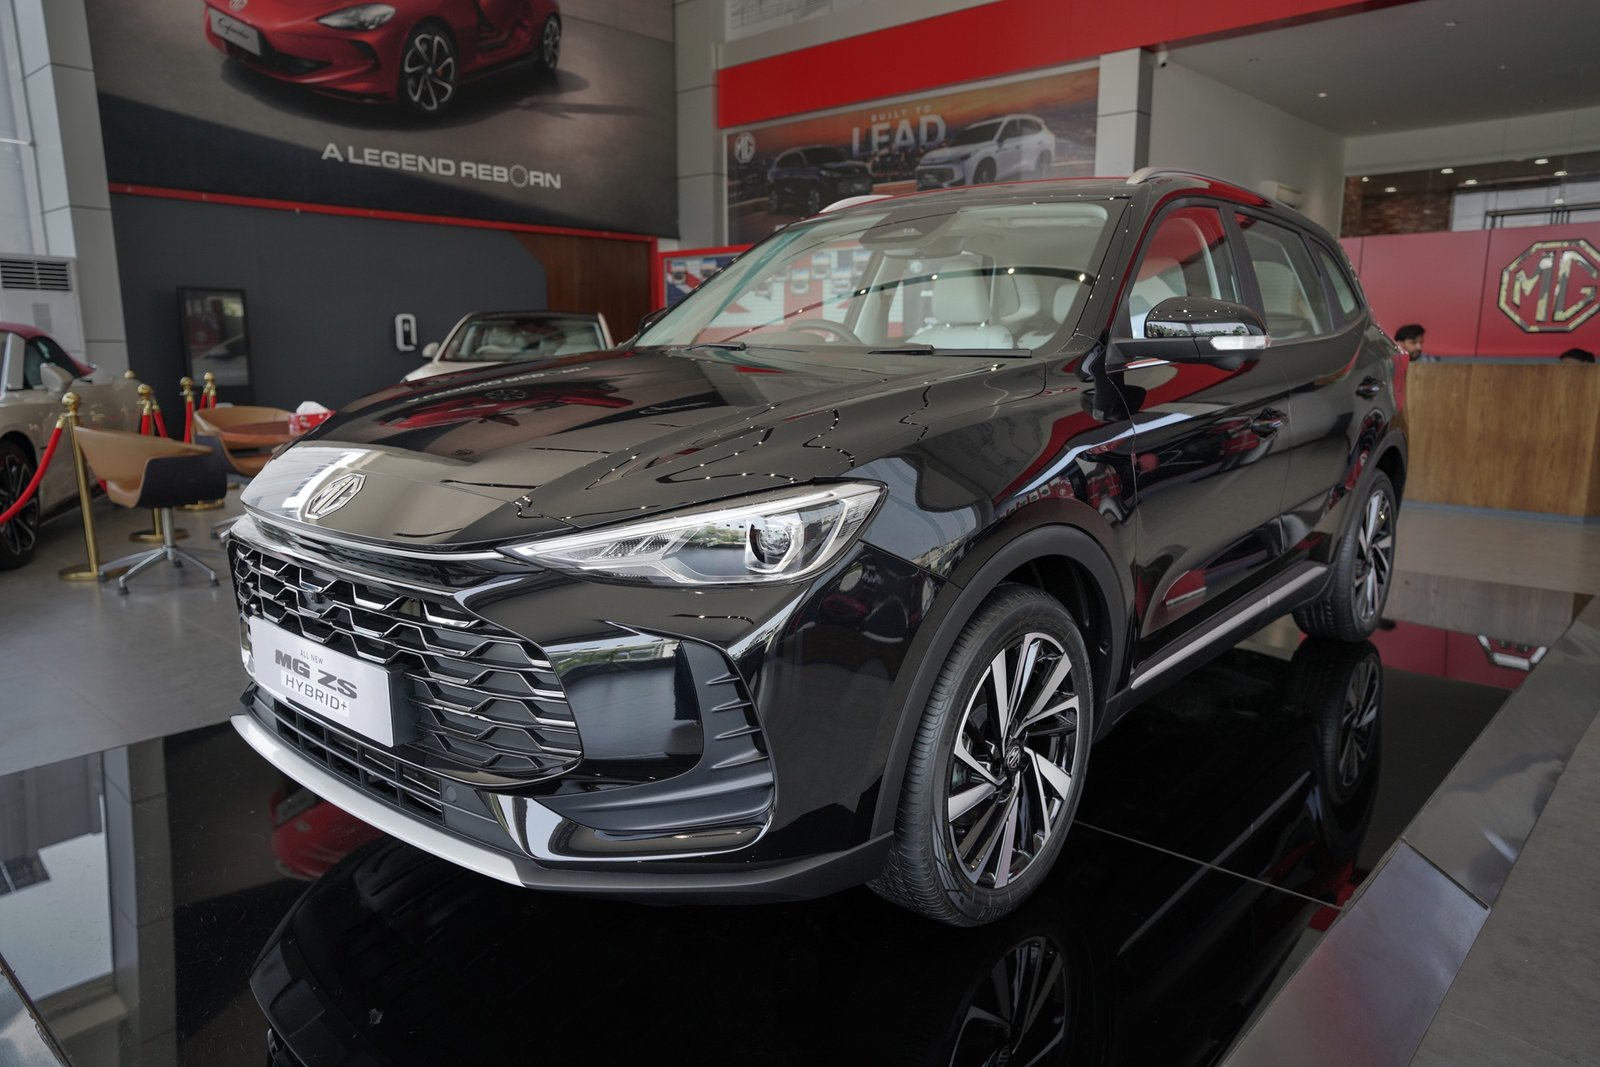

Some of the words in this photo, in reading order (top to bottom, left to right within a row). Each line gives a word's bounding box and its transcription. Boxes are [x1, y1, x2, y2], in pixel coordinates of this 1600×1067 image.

[871, 109, 907, 122] BUILT
[915, 104, 931, 115] TO
[851, 114, 946, 157] LEAD
[321, 142, 344, 162] A
[348, 146, 456, 176] LEGEND
[460, 161, 562, 189] REBORN
[1511, 249, 1598, 322] MG
[275, 649, 310, 679] MG
[317, 669, 358, 699] ZS
[300, 649, 310, 659] ALL
[310, 655, 323, 665] NEW
[285, 674, 347, 710] HYBRID+
